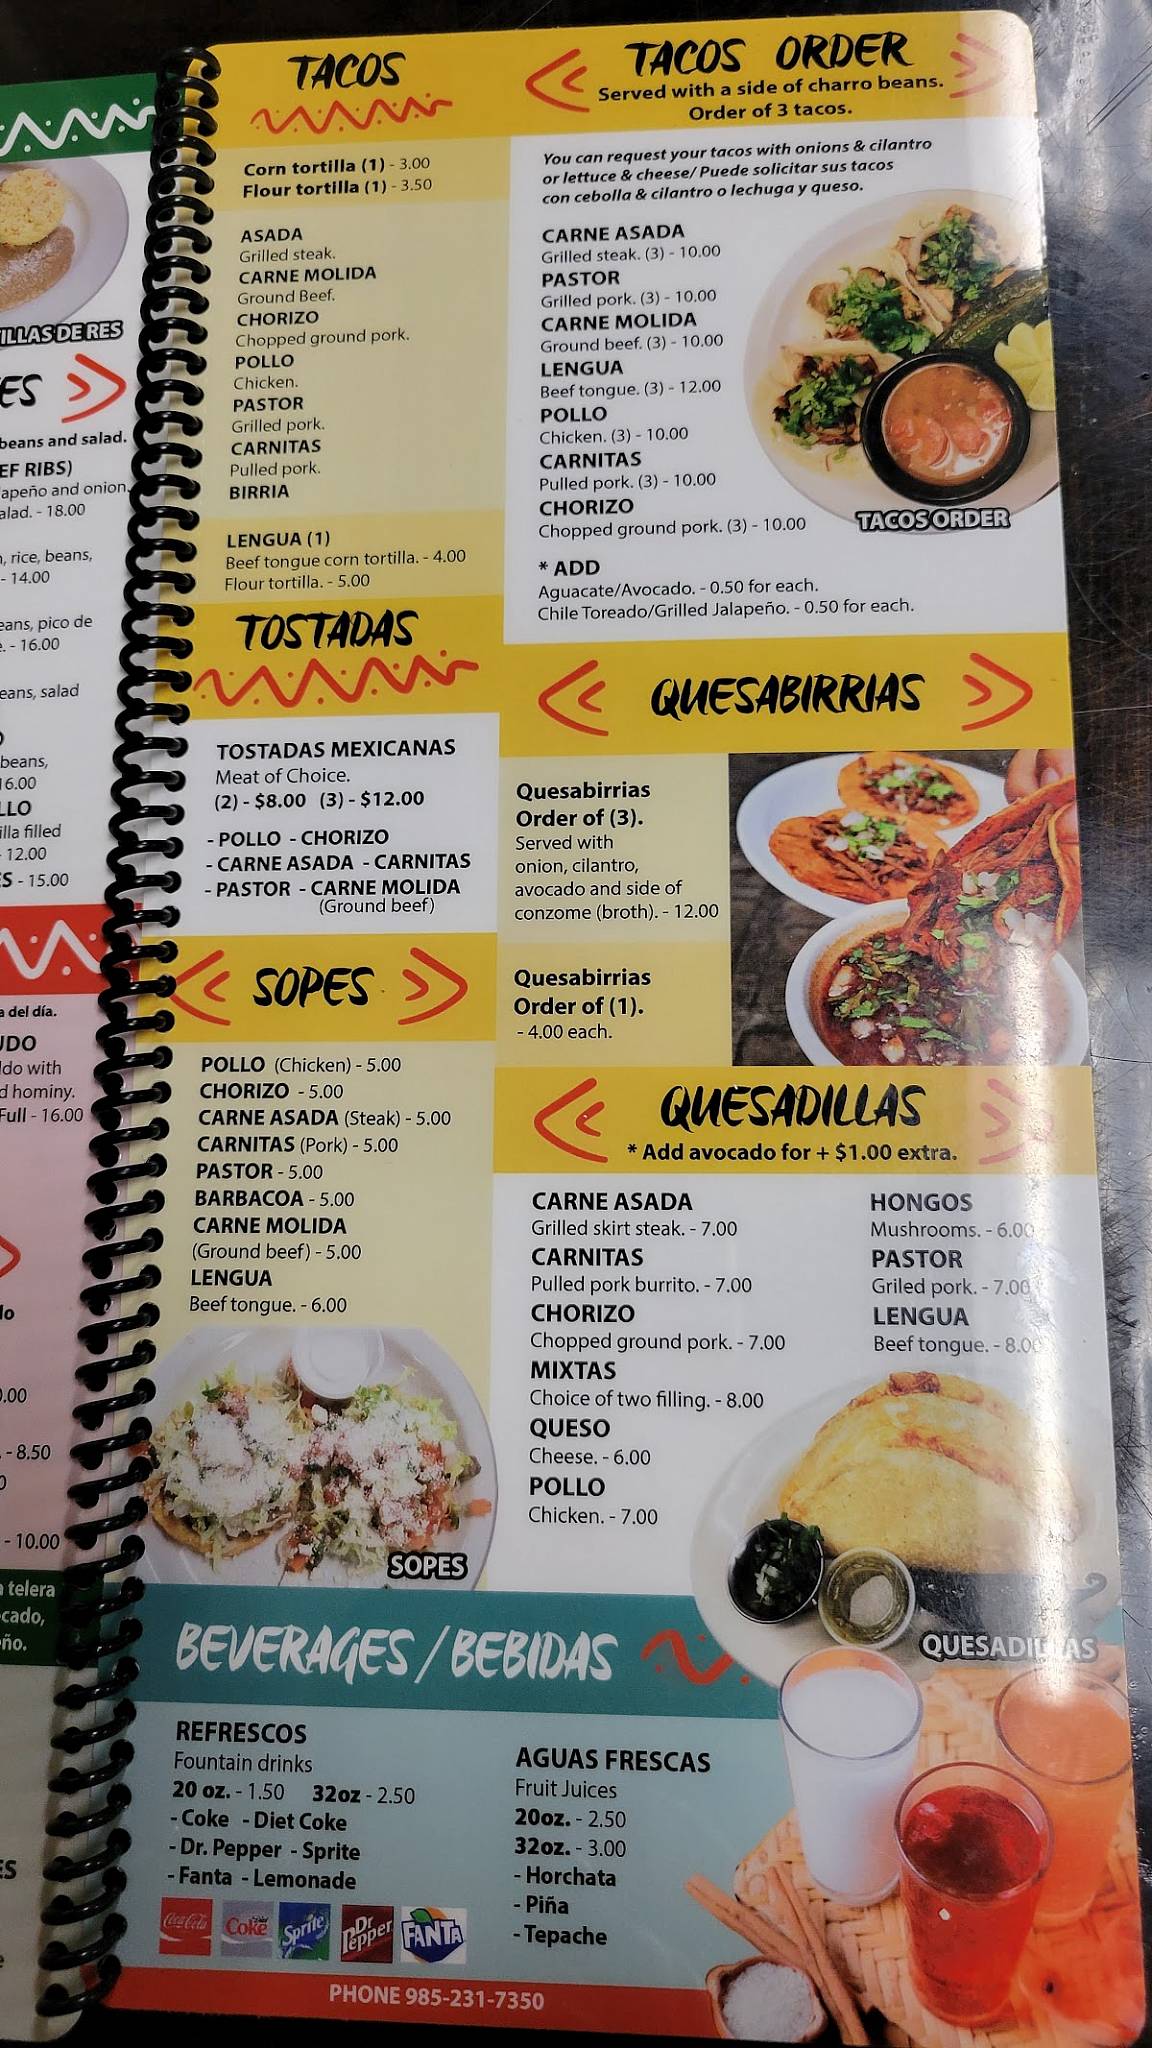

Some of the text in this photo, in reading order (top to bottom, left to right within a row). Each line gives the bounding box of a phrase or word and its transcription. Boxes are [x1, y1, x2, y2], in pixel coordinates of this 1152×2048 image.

[624, 31, 914, 77] TACOS ORDER
[287, 52, 406, 90] TACOS
[599, 75, 943, 101] Served with a side of charro beans.
[689, 103, 852, 121] Order of 3 tacos.
[244, 157, 430, 176] Corn tortilla (1) 3.00
[542, 182, 863, 204] con cebolla & cilantro o lechuga y queso.
[240, 228, 303, 243] ASADA
[239, 247, 335, 263] Grilled steak.
[541, 245, 721, 264] Grilled steak. (3) 10.00
[239, 266, 376, 284] CARNE MOLIDA
[542, 271, 620, 287] PASTOR
[237, 288, 335, 305] Ground Beef.
[56, 321, 123, 342] DE RES
[541, 360, 623, 377] LENGUA
[48, 433, 77, 447] and
[81, 430, 127, 445] salad.
[25, 460, 72, 477] RIBS)
[51, 482, 79, 496] and
[230, 484, 289, 500] BIRRIA
[47, 503, 85, 517] 18.00
[856, 508, 1010, 531] TACOS ORDER
[11, 549, 92, 564] rice, beans,
[226, 549, 466, 571] Beef tongue corn tortilla. 4.00
[554, 560, 600, 576] ADD
[538, 598, 914, 621] Chile Toreado/Grilled Jalapeño. 0.50 for each.
[38, 614, 93, 633] pico de
[235, 609, 419, 651] TOSTADAS
[21, 637, 60, 651] 16.00
[651, 672, 925, 721] QUESABIRRIAS
[217, 739, 455, 760] TOSTADAS MEXICANAS
[216, 767, 350, 785] Meat of Choice.
[215, 790, 424, 812] (2) $8.00 (3) $12.00
[516, 781, 651, 802] Quesabirrias
[516, 808, 643, 828] Order of (3).
[219, 829, 389, 847] POLLO CHORIZO
[515, 879, 683, 897] avocado and side of
[320, 897, 434, 915] (Ground beef)
[515, 904, 719, 922] conzome (broth). 12.00
[253, 966, 375, 1008] SOPES
[528, 1023, 612, 1039] 4.00 each.
[201, 1056, 401, 1075] POLLO (Chicken) 5.00
[12, 1084, 75, 1102] hominy.
[660, 1083, 926, 1133] QUESADILLAS
[199, 1109, 451, 1128] CARNE ASADA (Steak) 5.00
[643, 1143, 958, 1162] Add avocado for $1.00 extra.
[195, 1190, 354, 1207] BARBACOA 5.00
[871, 1193, 972, 1212] HONGOS
[870, 1221, 981, 1238] Mushrooms.
[532, 1248, 643, 1266] CARNITAS
[531, 1360, 616, 1380] MIXTAS
[530, 1389, 764, 1412] Choice of two filling. 8.00
[530, 1418, 610, 1440] QUESO
[16, 1533, 60, 1550] 10.00
[389, 1554, 465, 1577] SOPES
[8, 1579, 55, 1597] telera
[176, 1720, 307, 1744] REFRESCOS
[174, 1751, 312, 1773] Fountain drinks
[516, 1747, 710, 1773] AGUAS FRESCAS
[172, 1780, 415, 1805] 20 oz. 1.50 32oz 2.50
[182, 1808, 347, 1831] Coke Diet Coke
[181, 1837, 360, 1864] Dr. Pepper Sprite
[526, 1865, 616, 1887] Horchata
[526, 1895, 569, 1915] Piña
[225, 1916, 268, 1937] Coke
[282, 1915, 324, 1947] Sprite
[355, 1916, 373, 1935] Dr
[401, 1919, 463, 1949] FANTA
[342, 1919, 393, 1954] Pepper
[524, 1924, 607, 1948] Tepache
[330, 1984, 544, 2010] PHONE 985-231-7350
